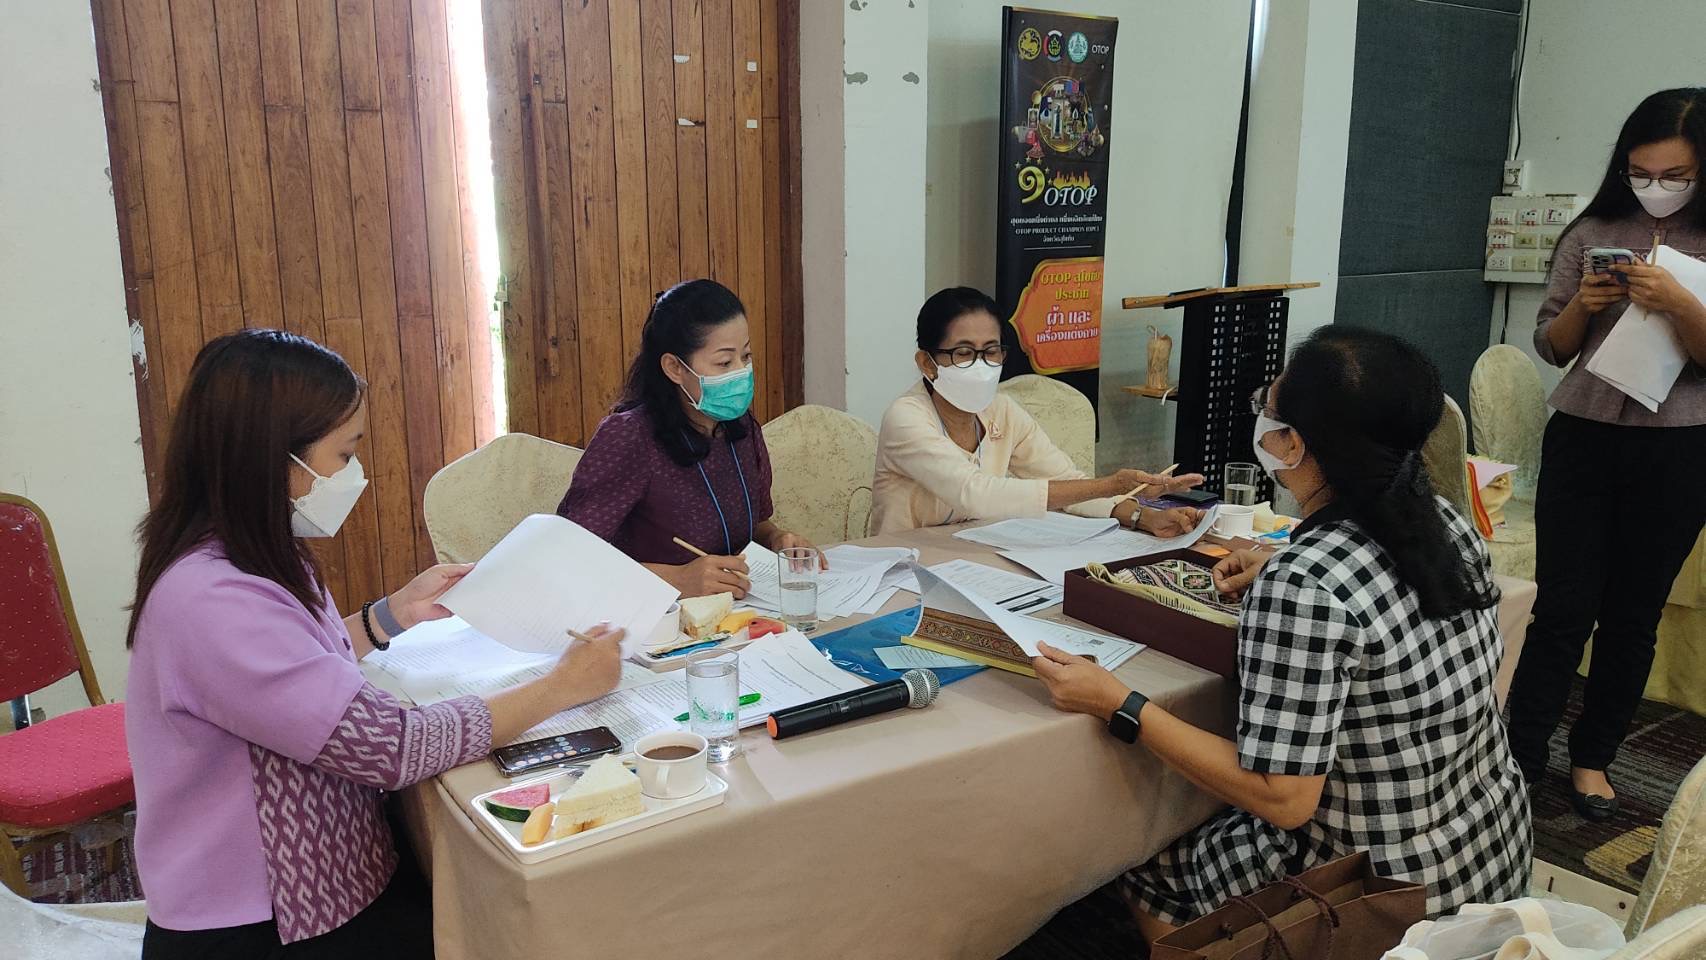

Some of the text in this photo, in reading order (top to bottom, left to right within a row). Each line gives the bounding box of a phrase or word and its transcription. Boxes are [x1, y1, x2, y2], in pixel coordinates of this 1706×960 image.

[1091, 44, 1109, 54] OTOP
[1044, 185, 1098, 206] OTOP
[1040, 272, 1071, 285] OTOP
[1046, 305, 1091, 326] ผ้า และ
[1036, 326, 1098, 344] เครื่องแต่งกาย
